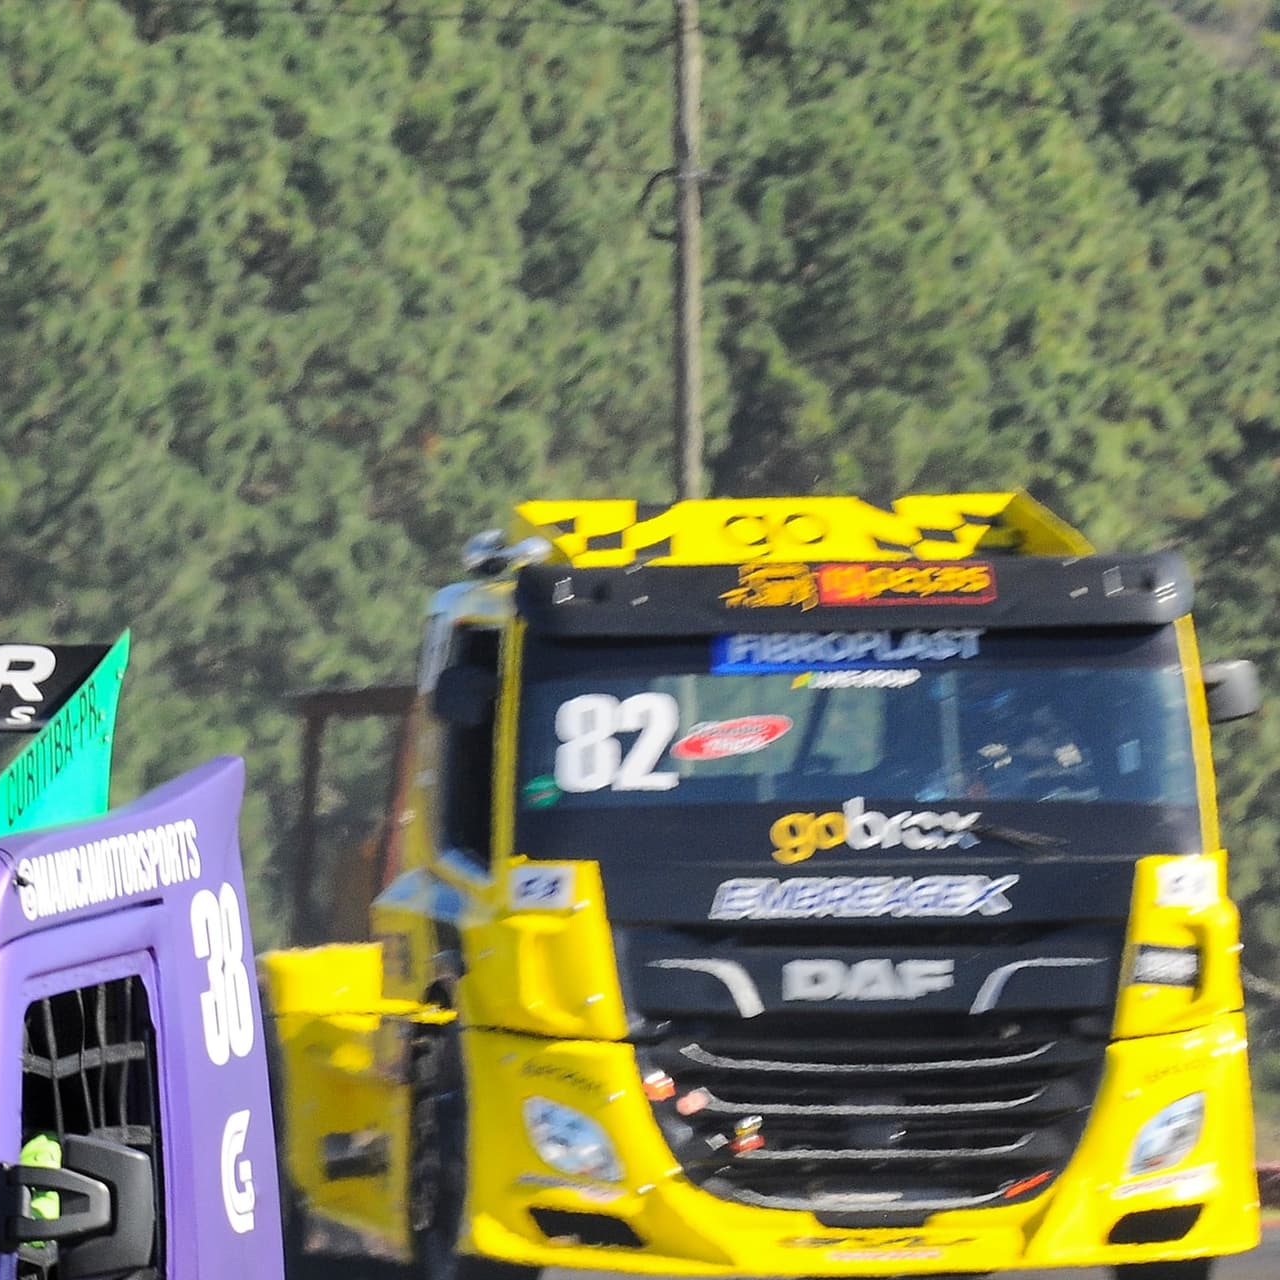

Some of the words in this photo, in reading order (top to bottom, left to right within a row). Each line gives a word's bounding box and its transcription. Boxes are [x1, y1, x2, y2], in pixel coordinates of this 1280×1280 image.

[554, 692, 680, 792] 82
[190, 882, 255, 1066] 38
[782, 958, 955, 1001] DAF
